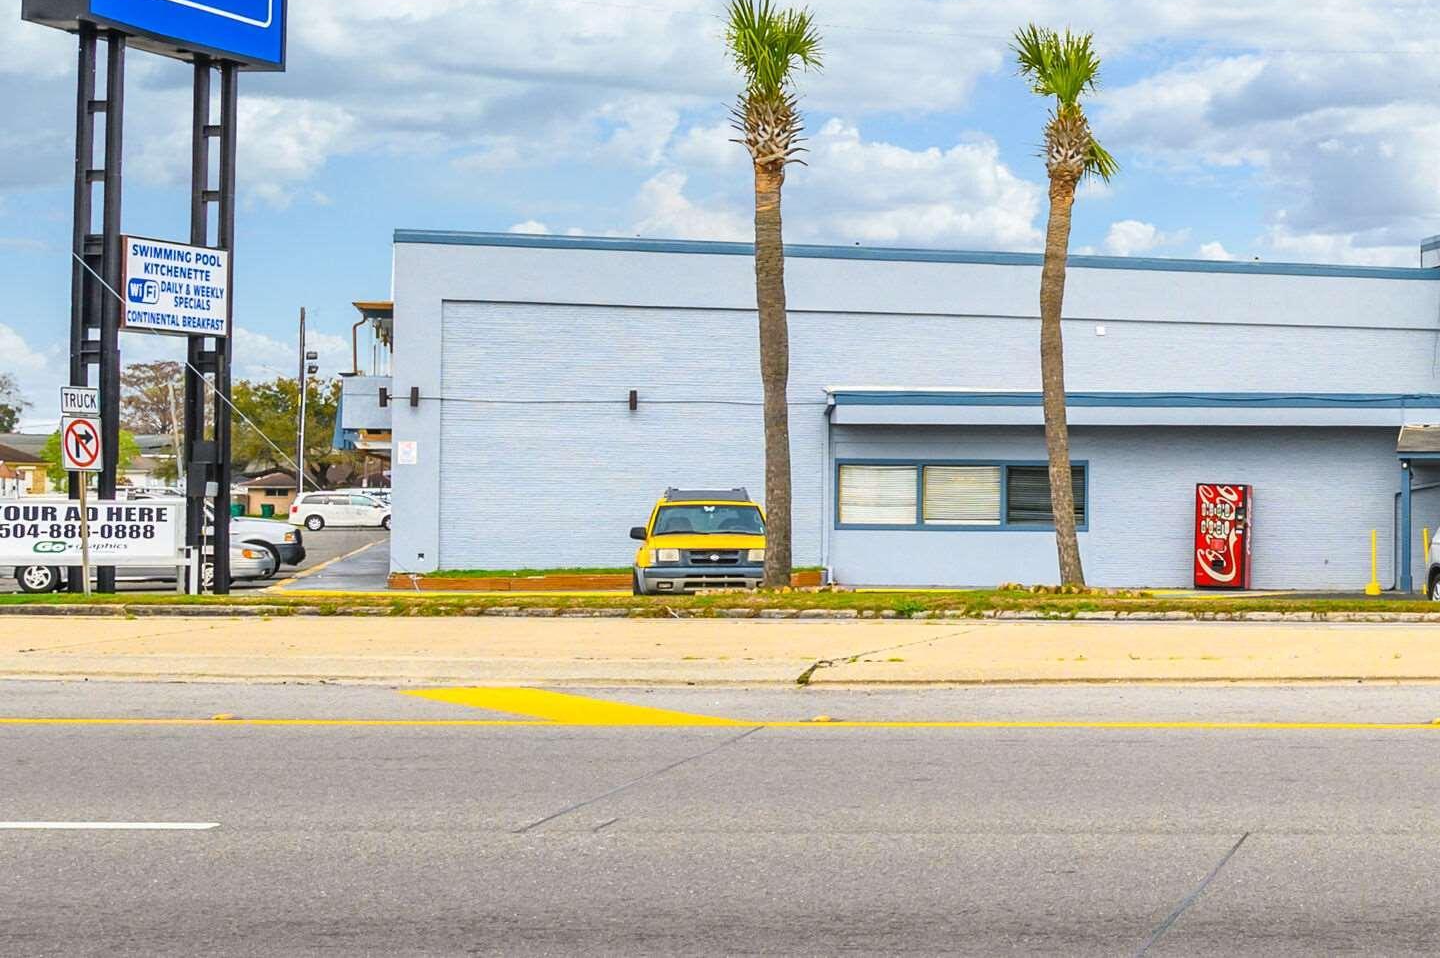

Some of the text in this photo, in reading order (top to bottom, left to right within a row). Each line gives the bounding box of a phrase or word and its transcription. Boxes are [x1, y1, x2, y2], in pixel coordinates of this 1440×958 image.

[132, 244, 222, 267] SWIMMING POOL
[144, 262, 211, 281] KITCHENETTE
[161, 281, 224, 299] DAILY & WEEKLY
[174, 296, 211, 311] SPECIALS
[127, 310, 224, 331] CONTINENTAL BREAKFAST
[63, 392, 97, 409] TRUCK
[0, 505, 168, 522] OUR AD HERE
